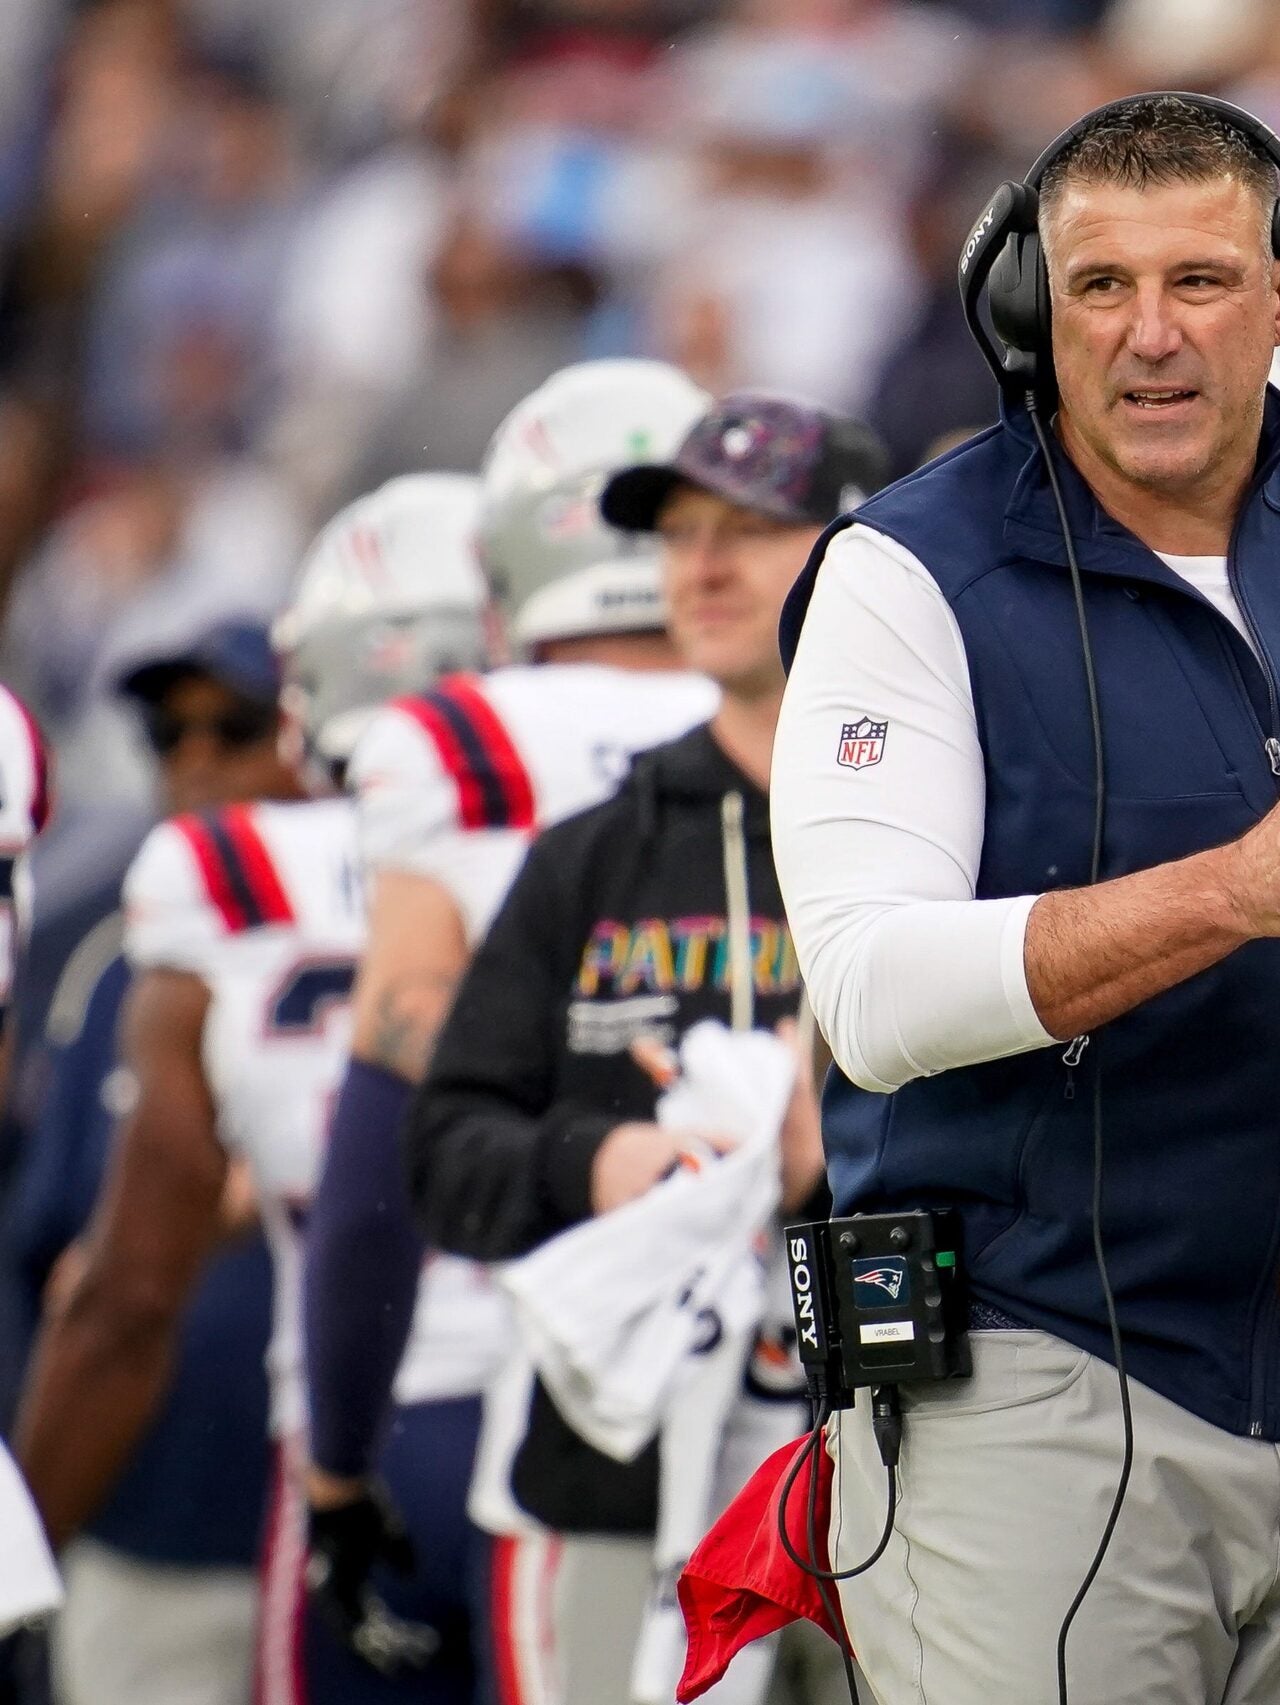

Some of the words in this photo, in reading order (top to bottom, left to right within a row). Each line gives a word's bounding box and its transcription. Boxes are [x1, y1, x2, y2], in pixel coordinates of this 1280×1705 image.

[961, 207, 994, 275] SONY
[841, 740, 879, 765] NFL
[790, 1237, 819, 1349] SONY
[873, 1327, 901, 1337] VRABEL
